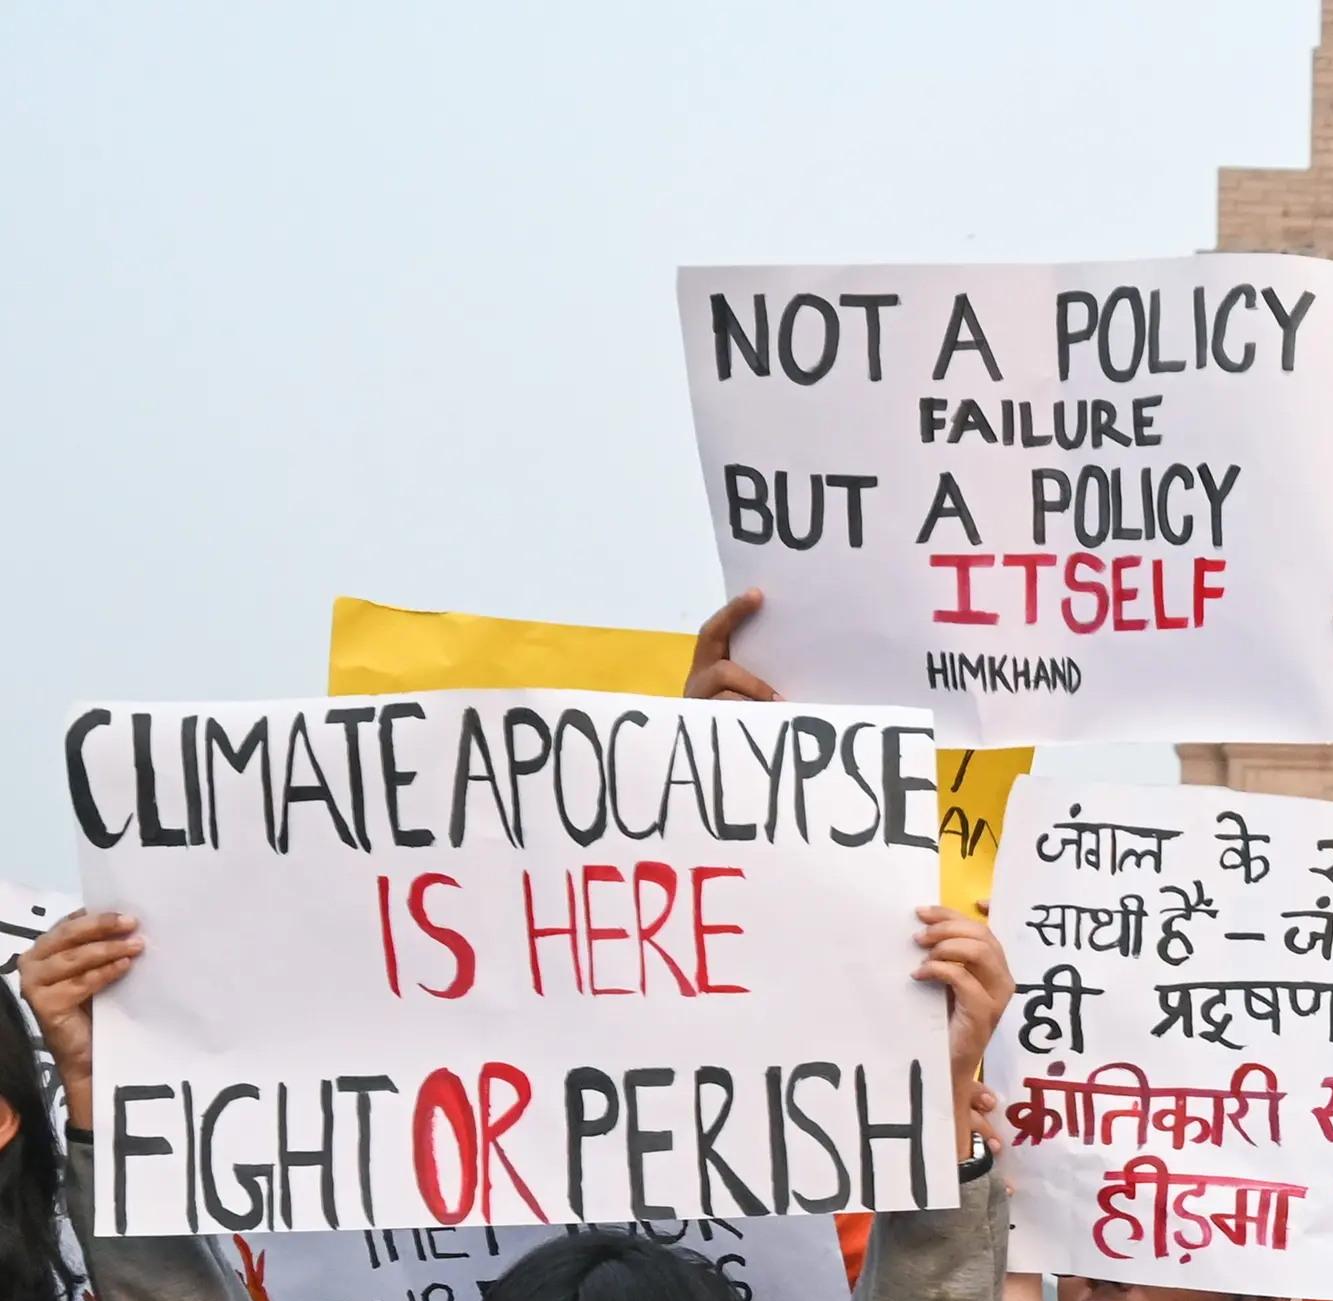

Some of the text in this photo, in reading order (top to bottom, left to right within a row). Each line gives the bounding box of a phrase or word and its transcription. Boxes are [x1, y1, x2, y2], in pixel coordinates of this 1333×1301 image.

[711, 284, 1316, 385] NOT A POLICY
[920, 395, 1163, 449] FAILURE
[724, 463, 1241, 550] BUT A POLICY
[929, 554, 1226, 634] ITSELF
[927, 650, 1081, 694] HIMKHAND
[66, 703, 938, 853] CLIMATE APOCALYPSE
[1036, 802, 1183, 875] जंगल
[1215, 811, 1271, 884] के
[378, 861, 751, 998] IS HERE
[1027, 894, 1149, 959] साथी
[1015, 962, 1104, 1055] ही
[114, 1058, 928, 1233] FIGHT OR PERISH
